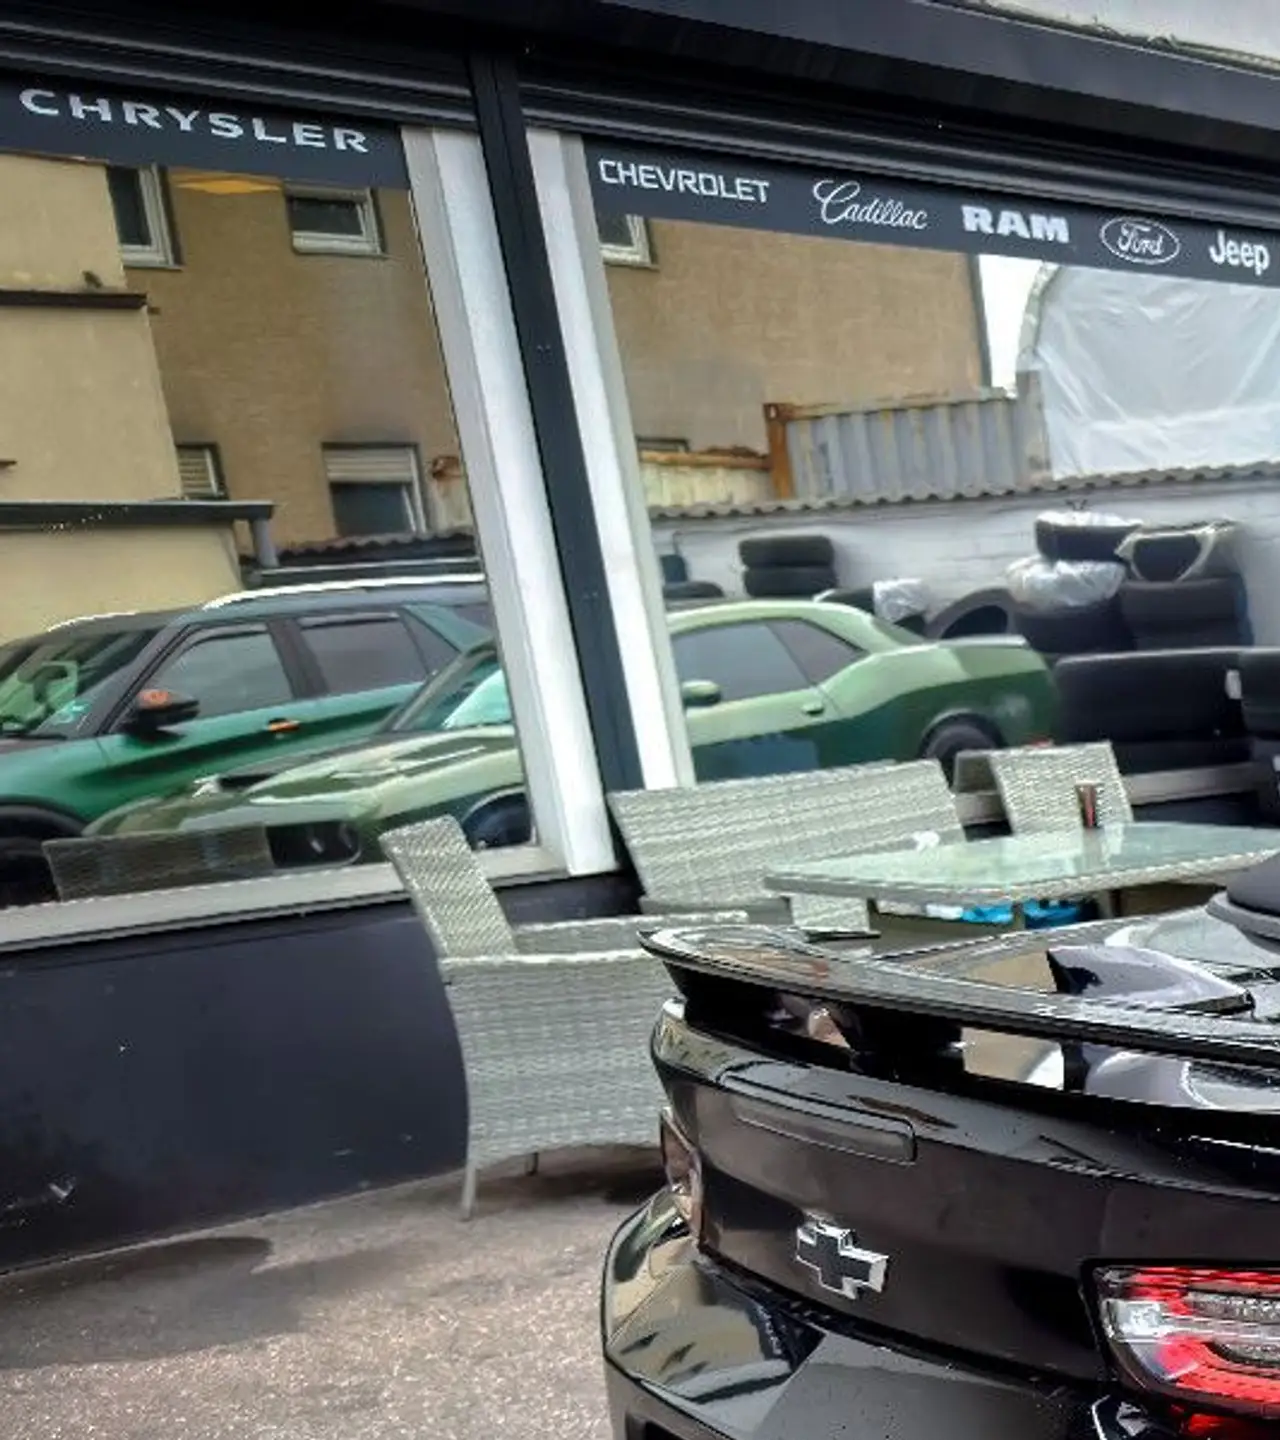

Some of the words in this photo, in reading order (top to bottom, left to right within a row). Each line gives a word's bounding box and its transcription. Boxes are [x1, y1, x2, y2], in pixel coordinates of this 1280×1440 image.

[19, 88, 370, 153] CHRYSLER
[598, 159, 770, 203] CHEVROLET
[811, 179, 928, 230] Cadillac
[960, 204, 1070, 243] RAM
[1117, 222, 1165, 256] Ford
[1209, 229, 1271, 276] Jeep
